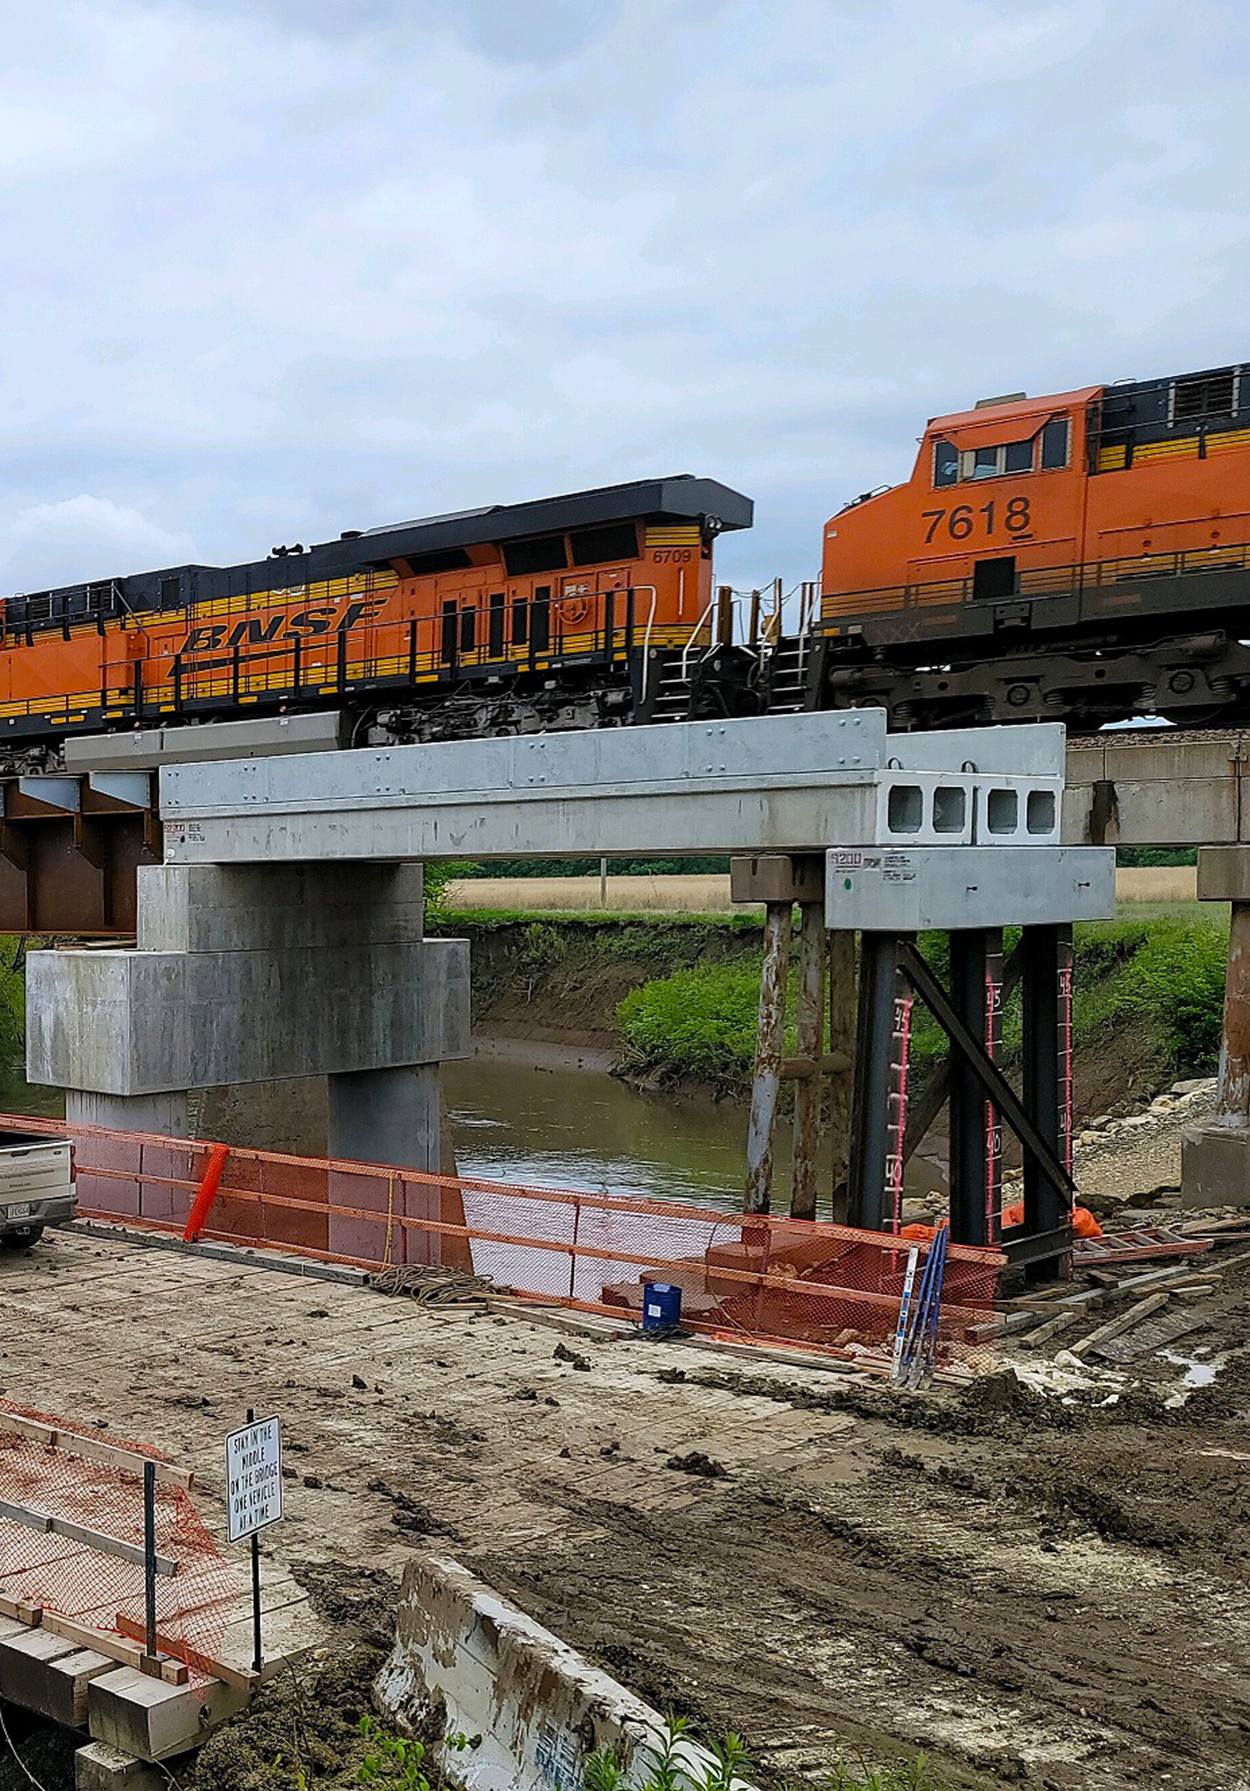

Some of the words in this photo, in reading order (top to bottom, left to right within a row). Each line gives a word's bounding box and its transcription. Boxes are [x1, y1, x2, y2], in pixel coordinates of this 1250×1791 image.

[921, 496, 1030, 543] 7618
[652, 549, 691, 564] 6709
[180, 597, 391, 654] BNSF
[234, 1434, 249, 1454] STAY
[250, 1428, 259, 1446] IN
[259, 1424, 272, 1443] THE
[242, 1446, 265, 1471] MIDDLE
[230, 1478, 239, 1496] ON
[241, 1472, 253, 1491] THE
[254, 1461, 278, 1484] BRIDGE
[234, 1494, 247, 1514] ONE
[249, 1482, 276, 1507] VEHICLE
[239, 1514, 247, 1532] AT
[254, 1503, 270, 1525] TIME
